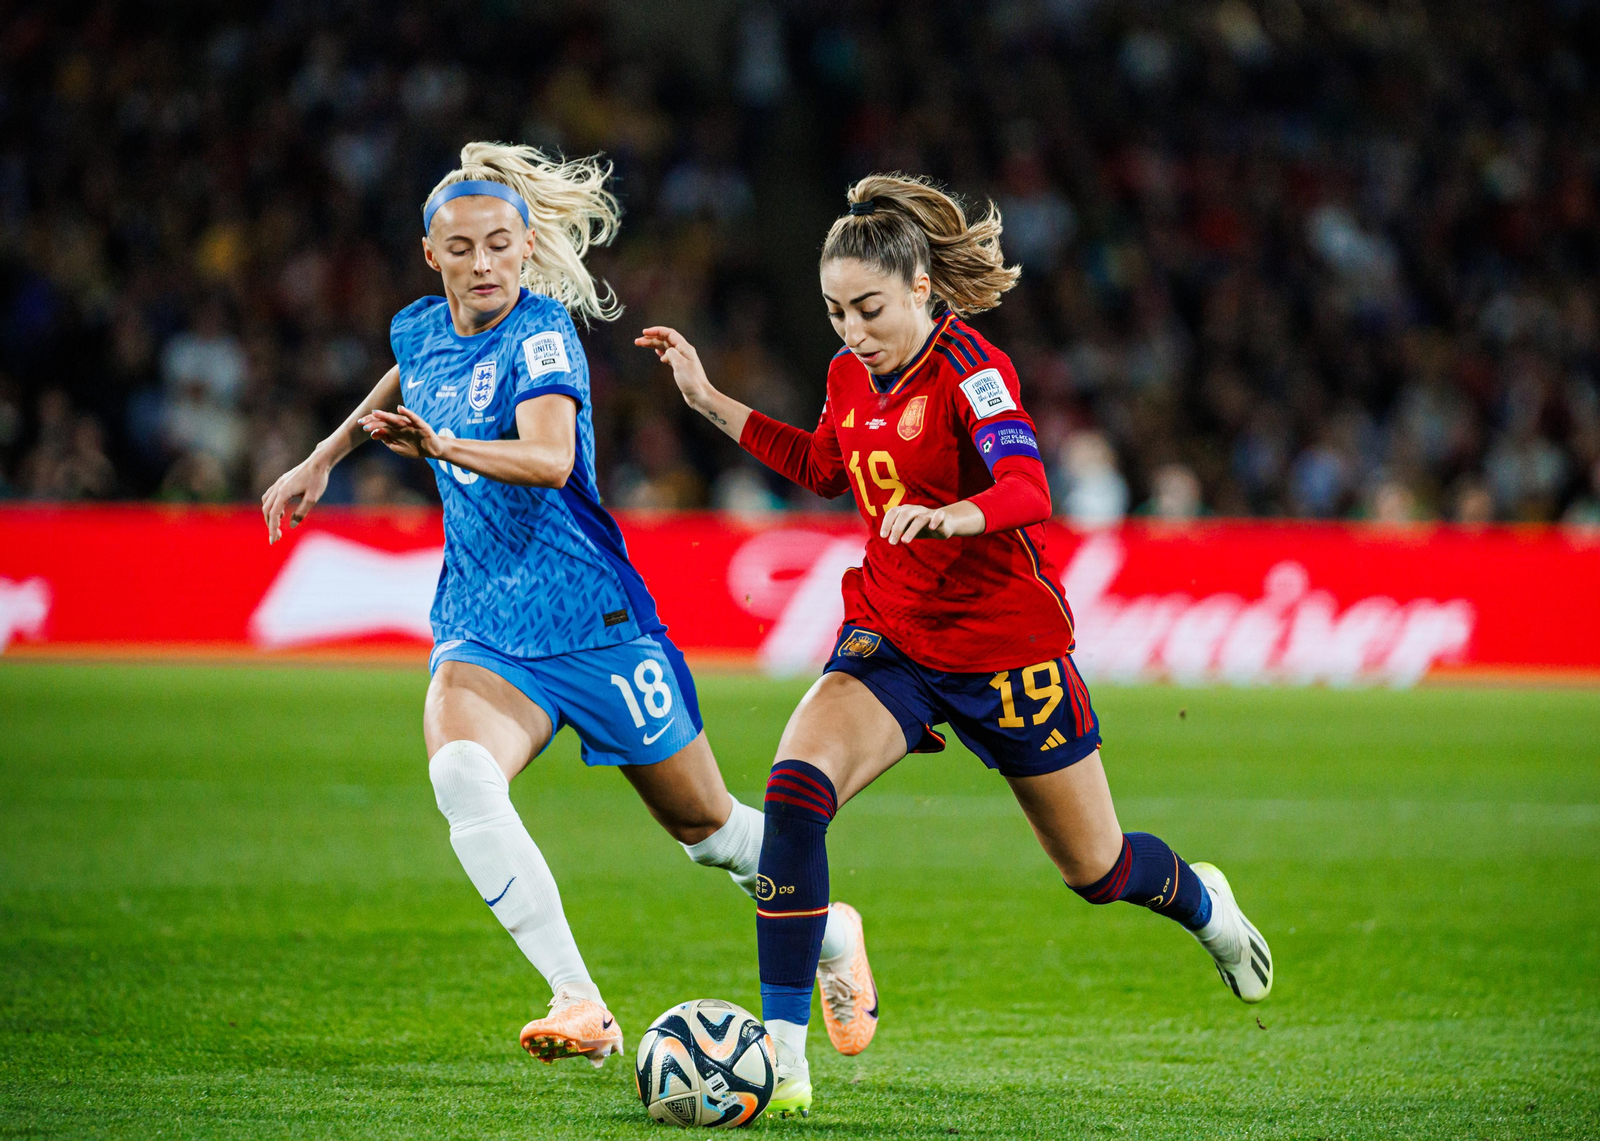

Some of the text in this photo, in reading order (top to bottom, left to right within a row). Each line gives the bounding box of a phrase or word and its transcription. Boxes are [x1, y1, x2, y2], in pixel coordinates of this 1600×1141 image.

[533, 343, 557, 354] UNITES
[975, 381, 999, 395] UNITES
[848, 450, 907, 517] 19
[610, 658, 673, 729] 18
[988, 659, 1064, 728] 19
[778, 885, 795, 895] 09
